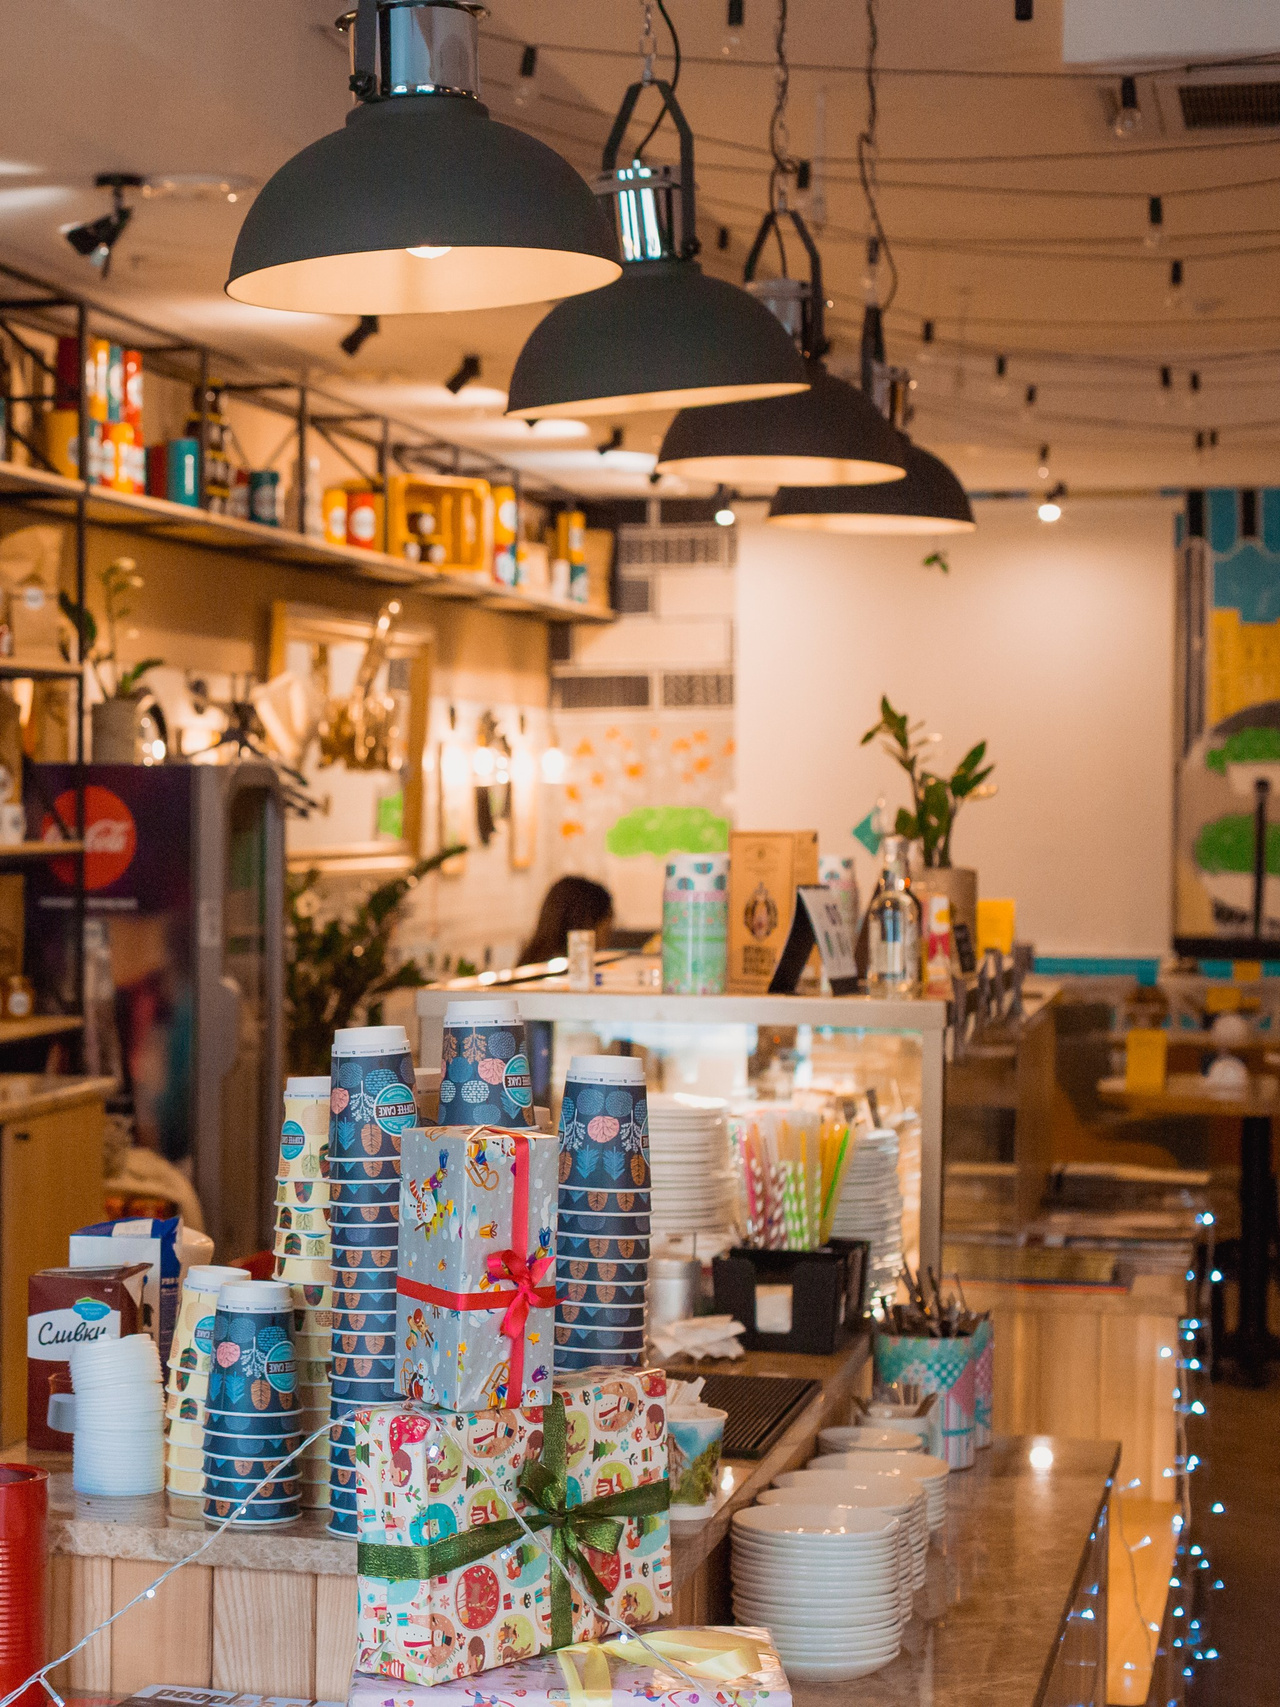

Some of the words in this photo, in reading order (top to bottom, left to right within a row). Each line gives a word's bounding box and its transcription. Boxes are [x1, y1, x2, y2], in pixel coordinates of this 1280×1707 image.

[378, 1105, 396, 1117] CAKE
[396, 1103, 415, 1115] COFFEE
[38, 1321, 107, 1346] Сливки
